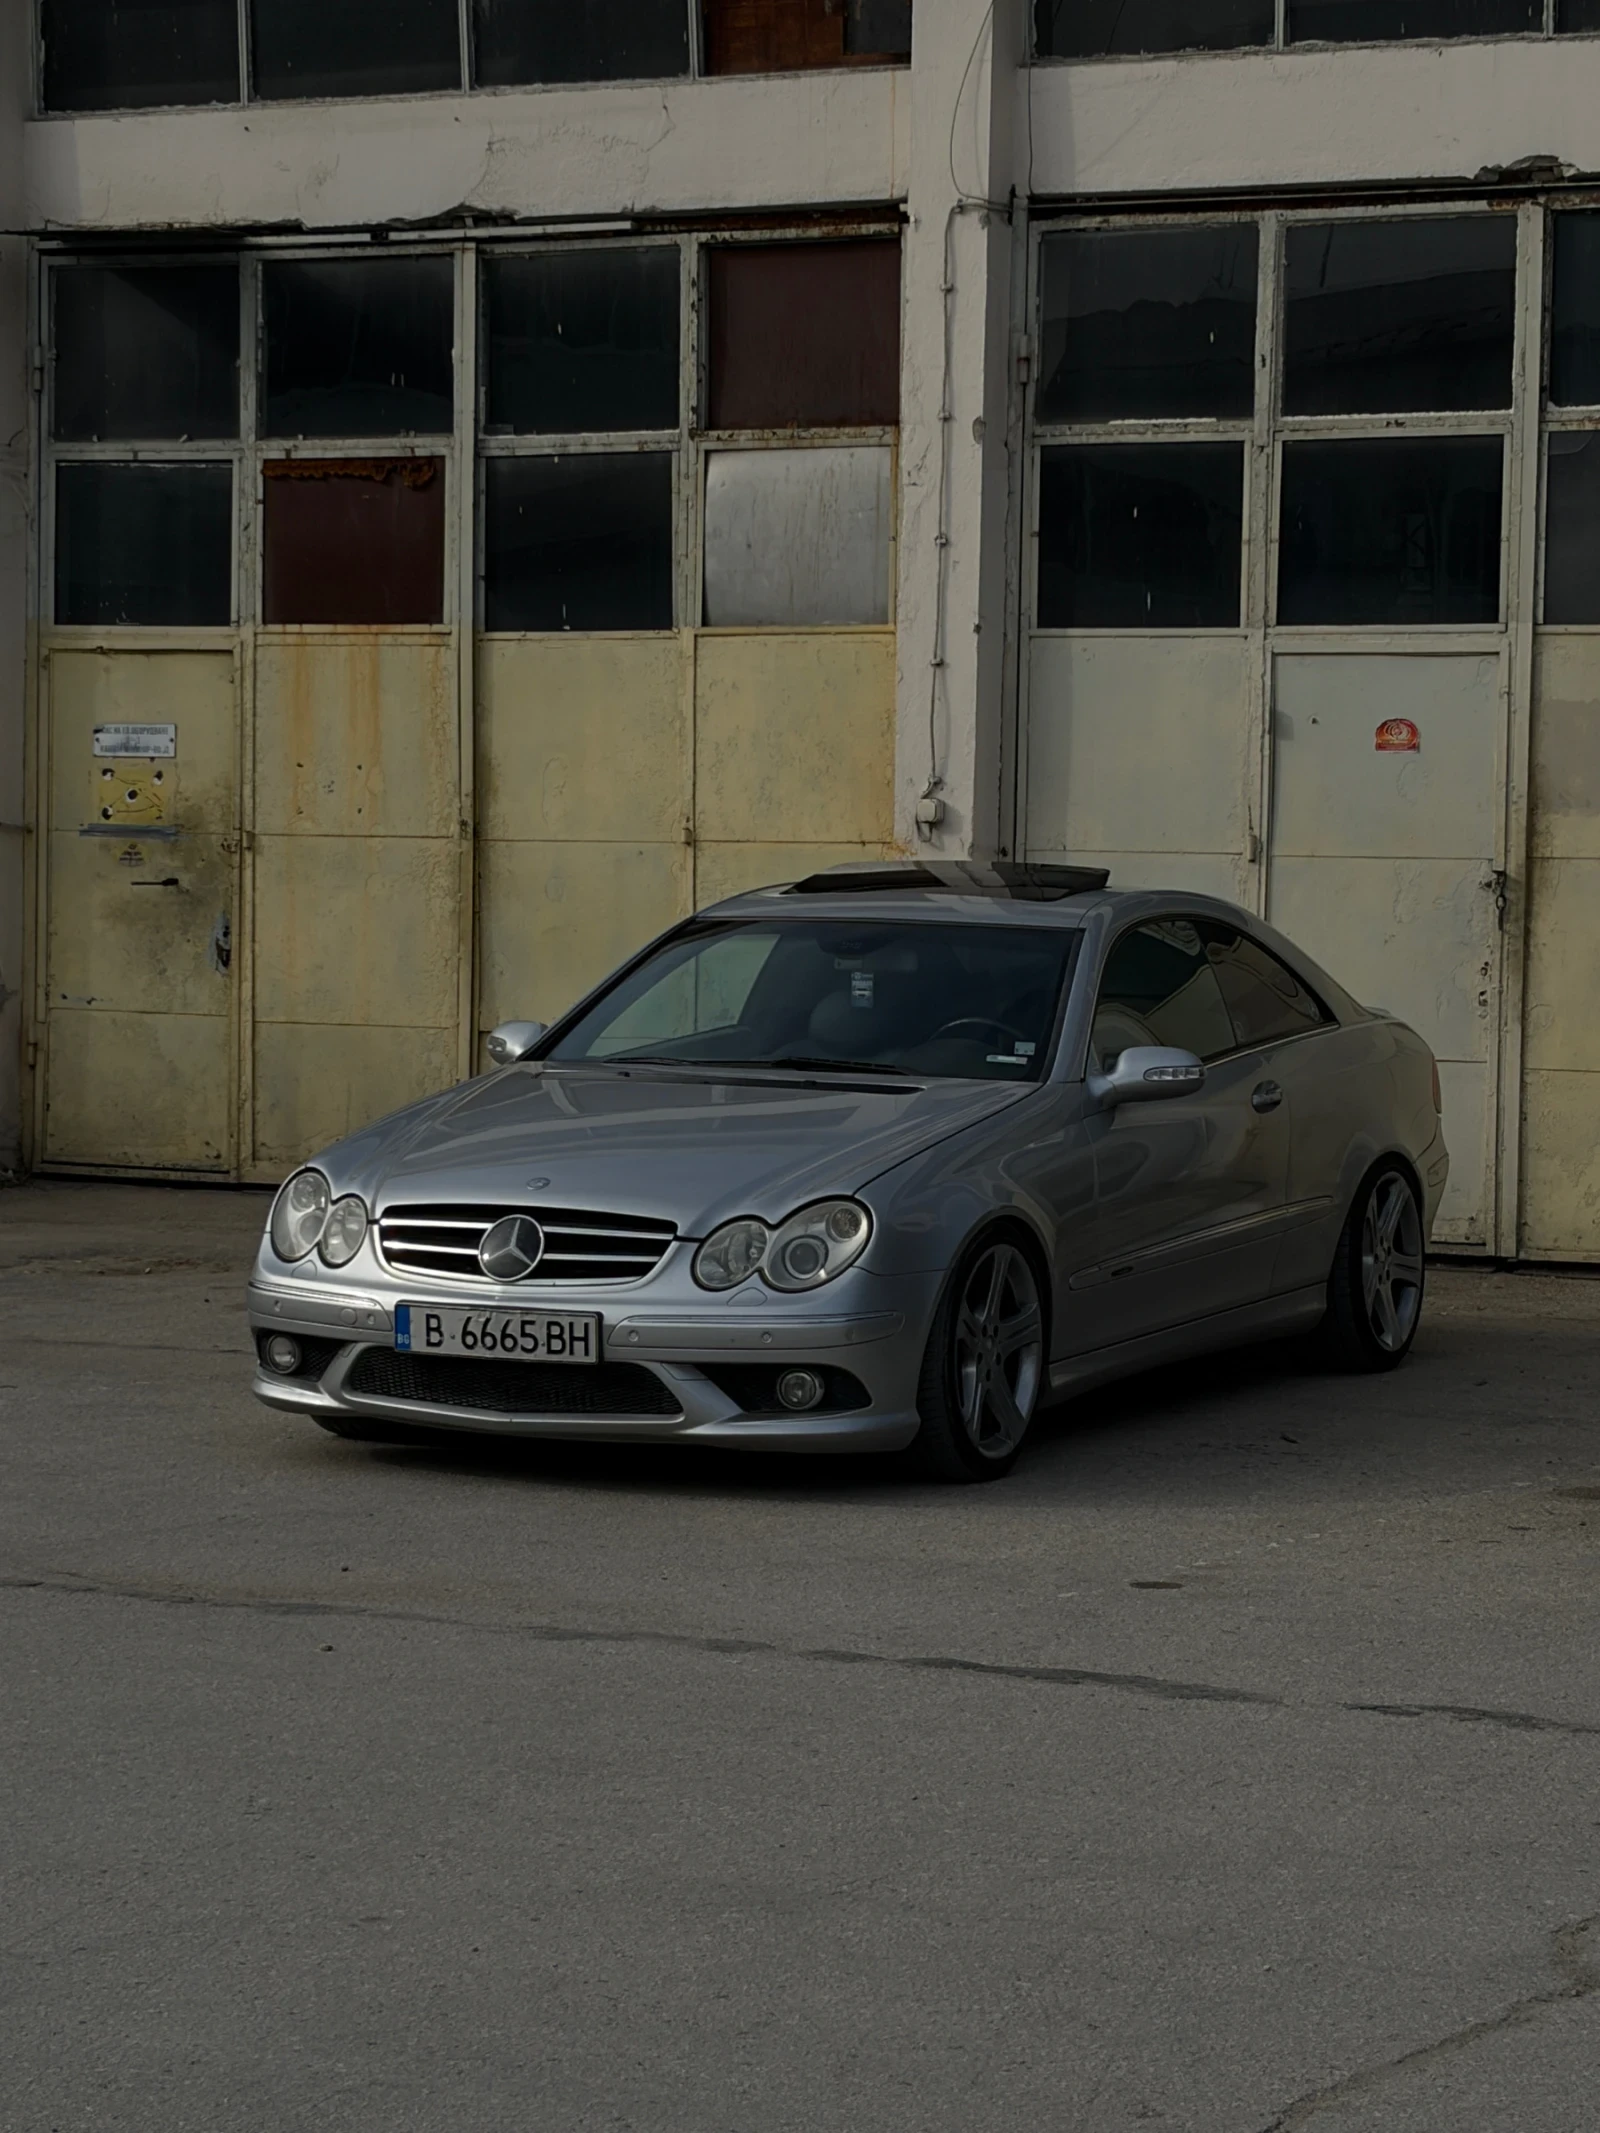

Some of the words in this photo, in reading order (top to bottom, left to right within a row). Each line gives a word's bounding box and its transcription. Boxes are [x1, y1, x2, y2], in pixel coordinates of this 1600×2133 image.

[396, 1332, 410, 1345] BG
[425, 1313, 445, 1348] B
[461, 1316, 539, 1354] 6665
[546, 1321, 590, 1357] BH
